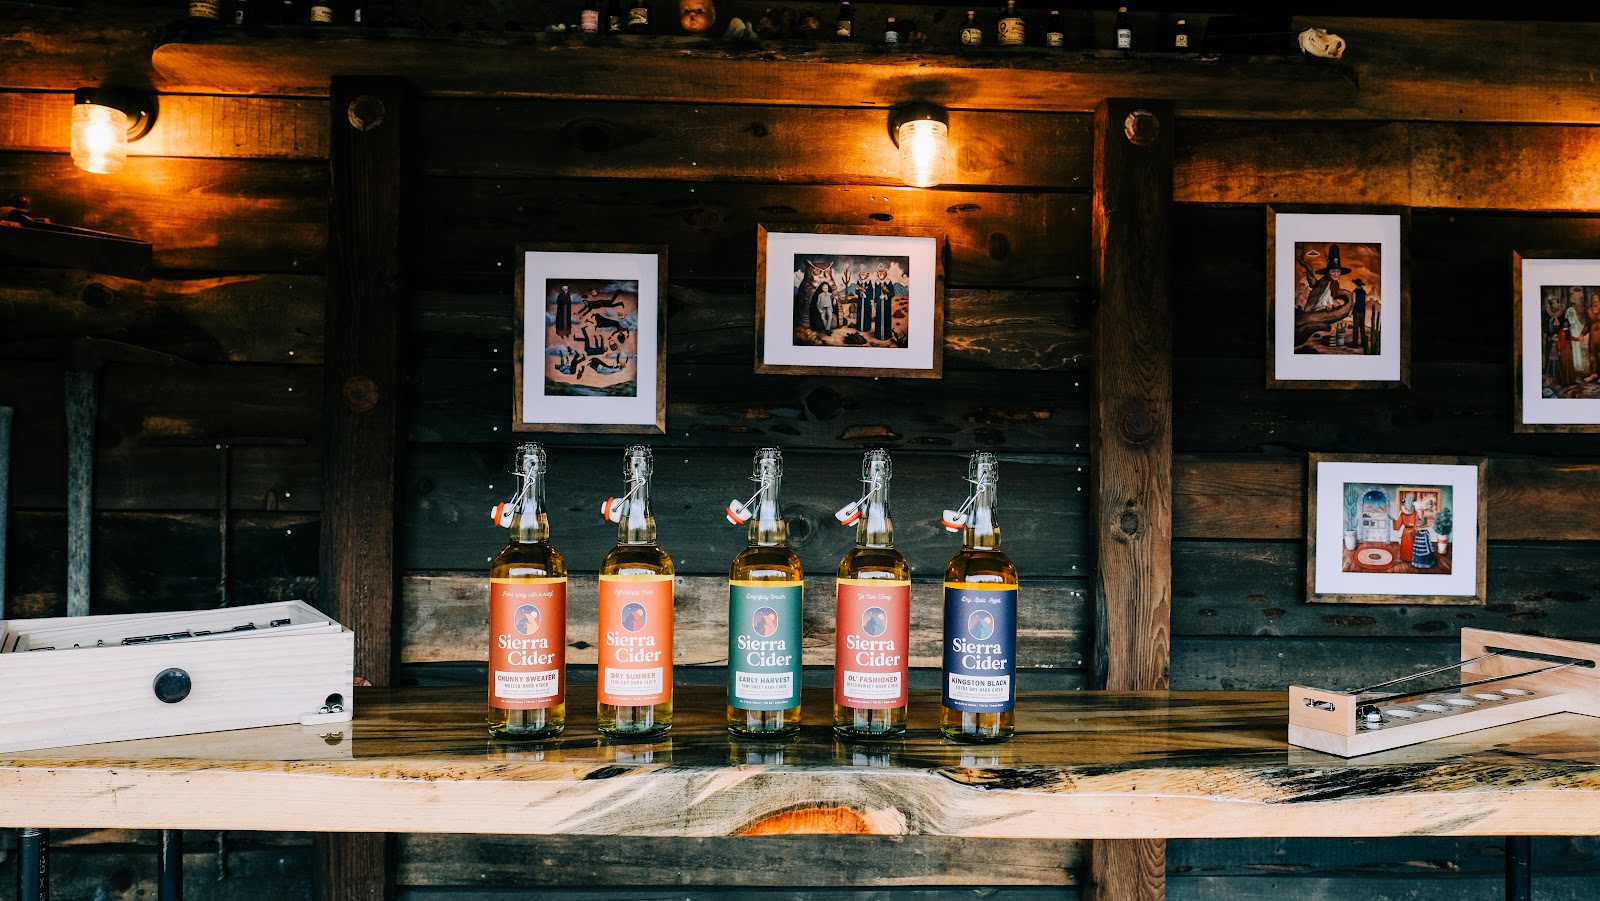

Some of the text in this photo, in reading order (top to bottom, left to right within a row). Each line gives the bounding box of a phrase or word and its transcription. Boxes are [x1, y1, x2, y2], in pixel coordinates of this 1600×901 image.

[498, 634, 549, 649] Sierra
[606, 630, 655, 646] Sierra
[737, 634, 786, 650] Sierra
[846, 634, 895, 650] Sierra
[952, 638, 1002, 654] Sierra
[507, 650, 556, 666] Cider
[614, 647, 662, 662] Cider
[746, 651, 792, 666] Cider
[855, 651, 900, 666] Cider
[961, 654, 1008, 670] Cider
[497, 673, 556, 682] CHUNKY SWEATER
[625, 672, 656, 680] SUMMER
[738, 675, 790, 684] EARLY HARVEST
[951, 677, 985, 687] KINGSTON
